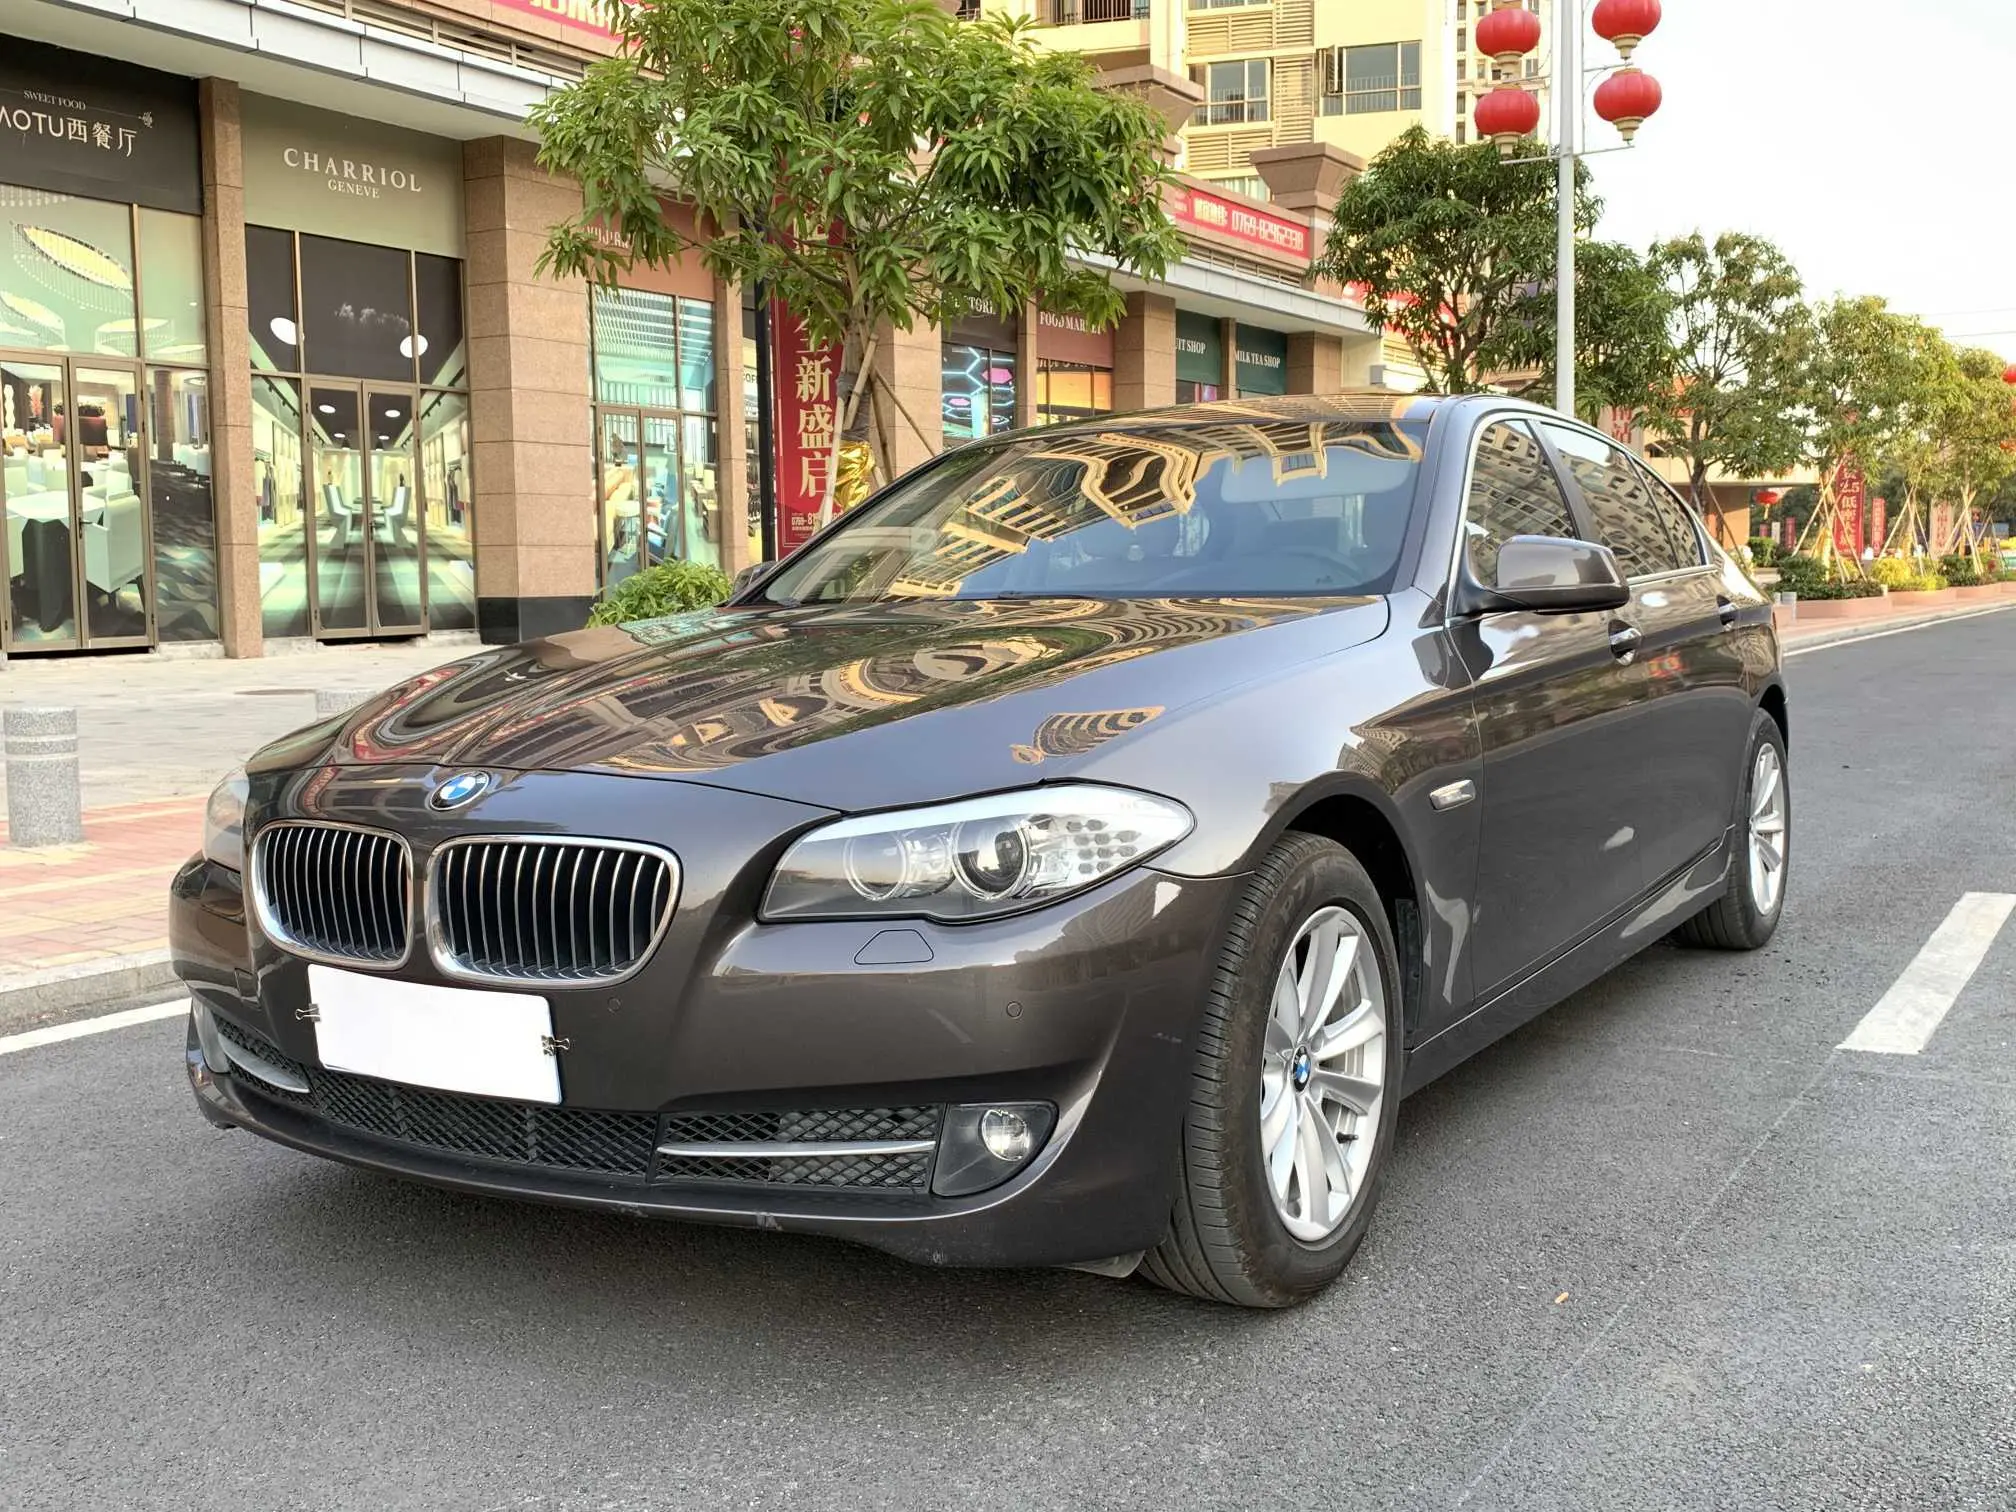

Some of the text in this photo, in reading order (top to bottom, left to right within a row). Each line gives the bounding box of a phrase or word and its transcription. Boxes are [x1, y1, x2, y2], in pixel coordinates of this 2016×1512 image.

[23, 89, 87, 110] SWEET FOOD
[283, 147, 422, 192] CHARRIOL
[327, 178, 380, 199] GENEVE
[964, 295, 996, 315] TOR
[1039, 311, 1104, 335] FOOD MAR
[1186, 339, 1206, 355] SHOP
[1250, 352, 1264, 367] TEA
[1263, 354, 1281, 369] SHOP
